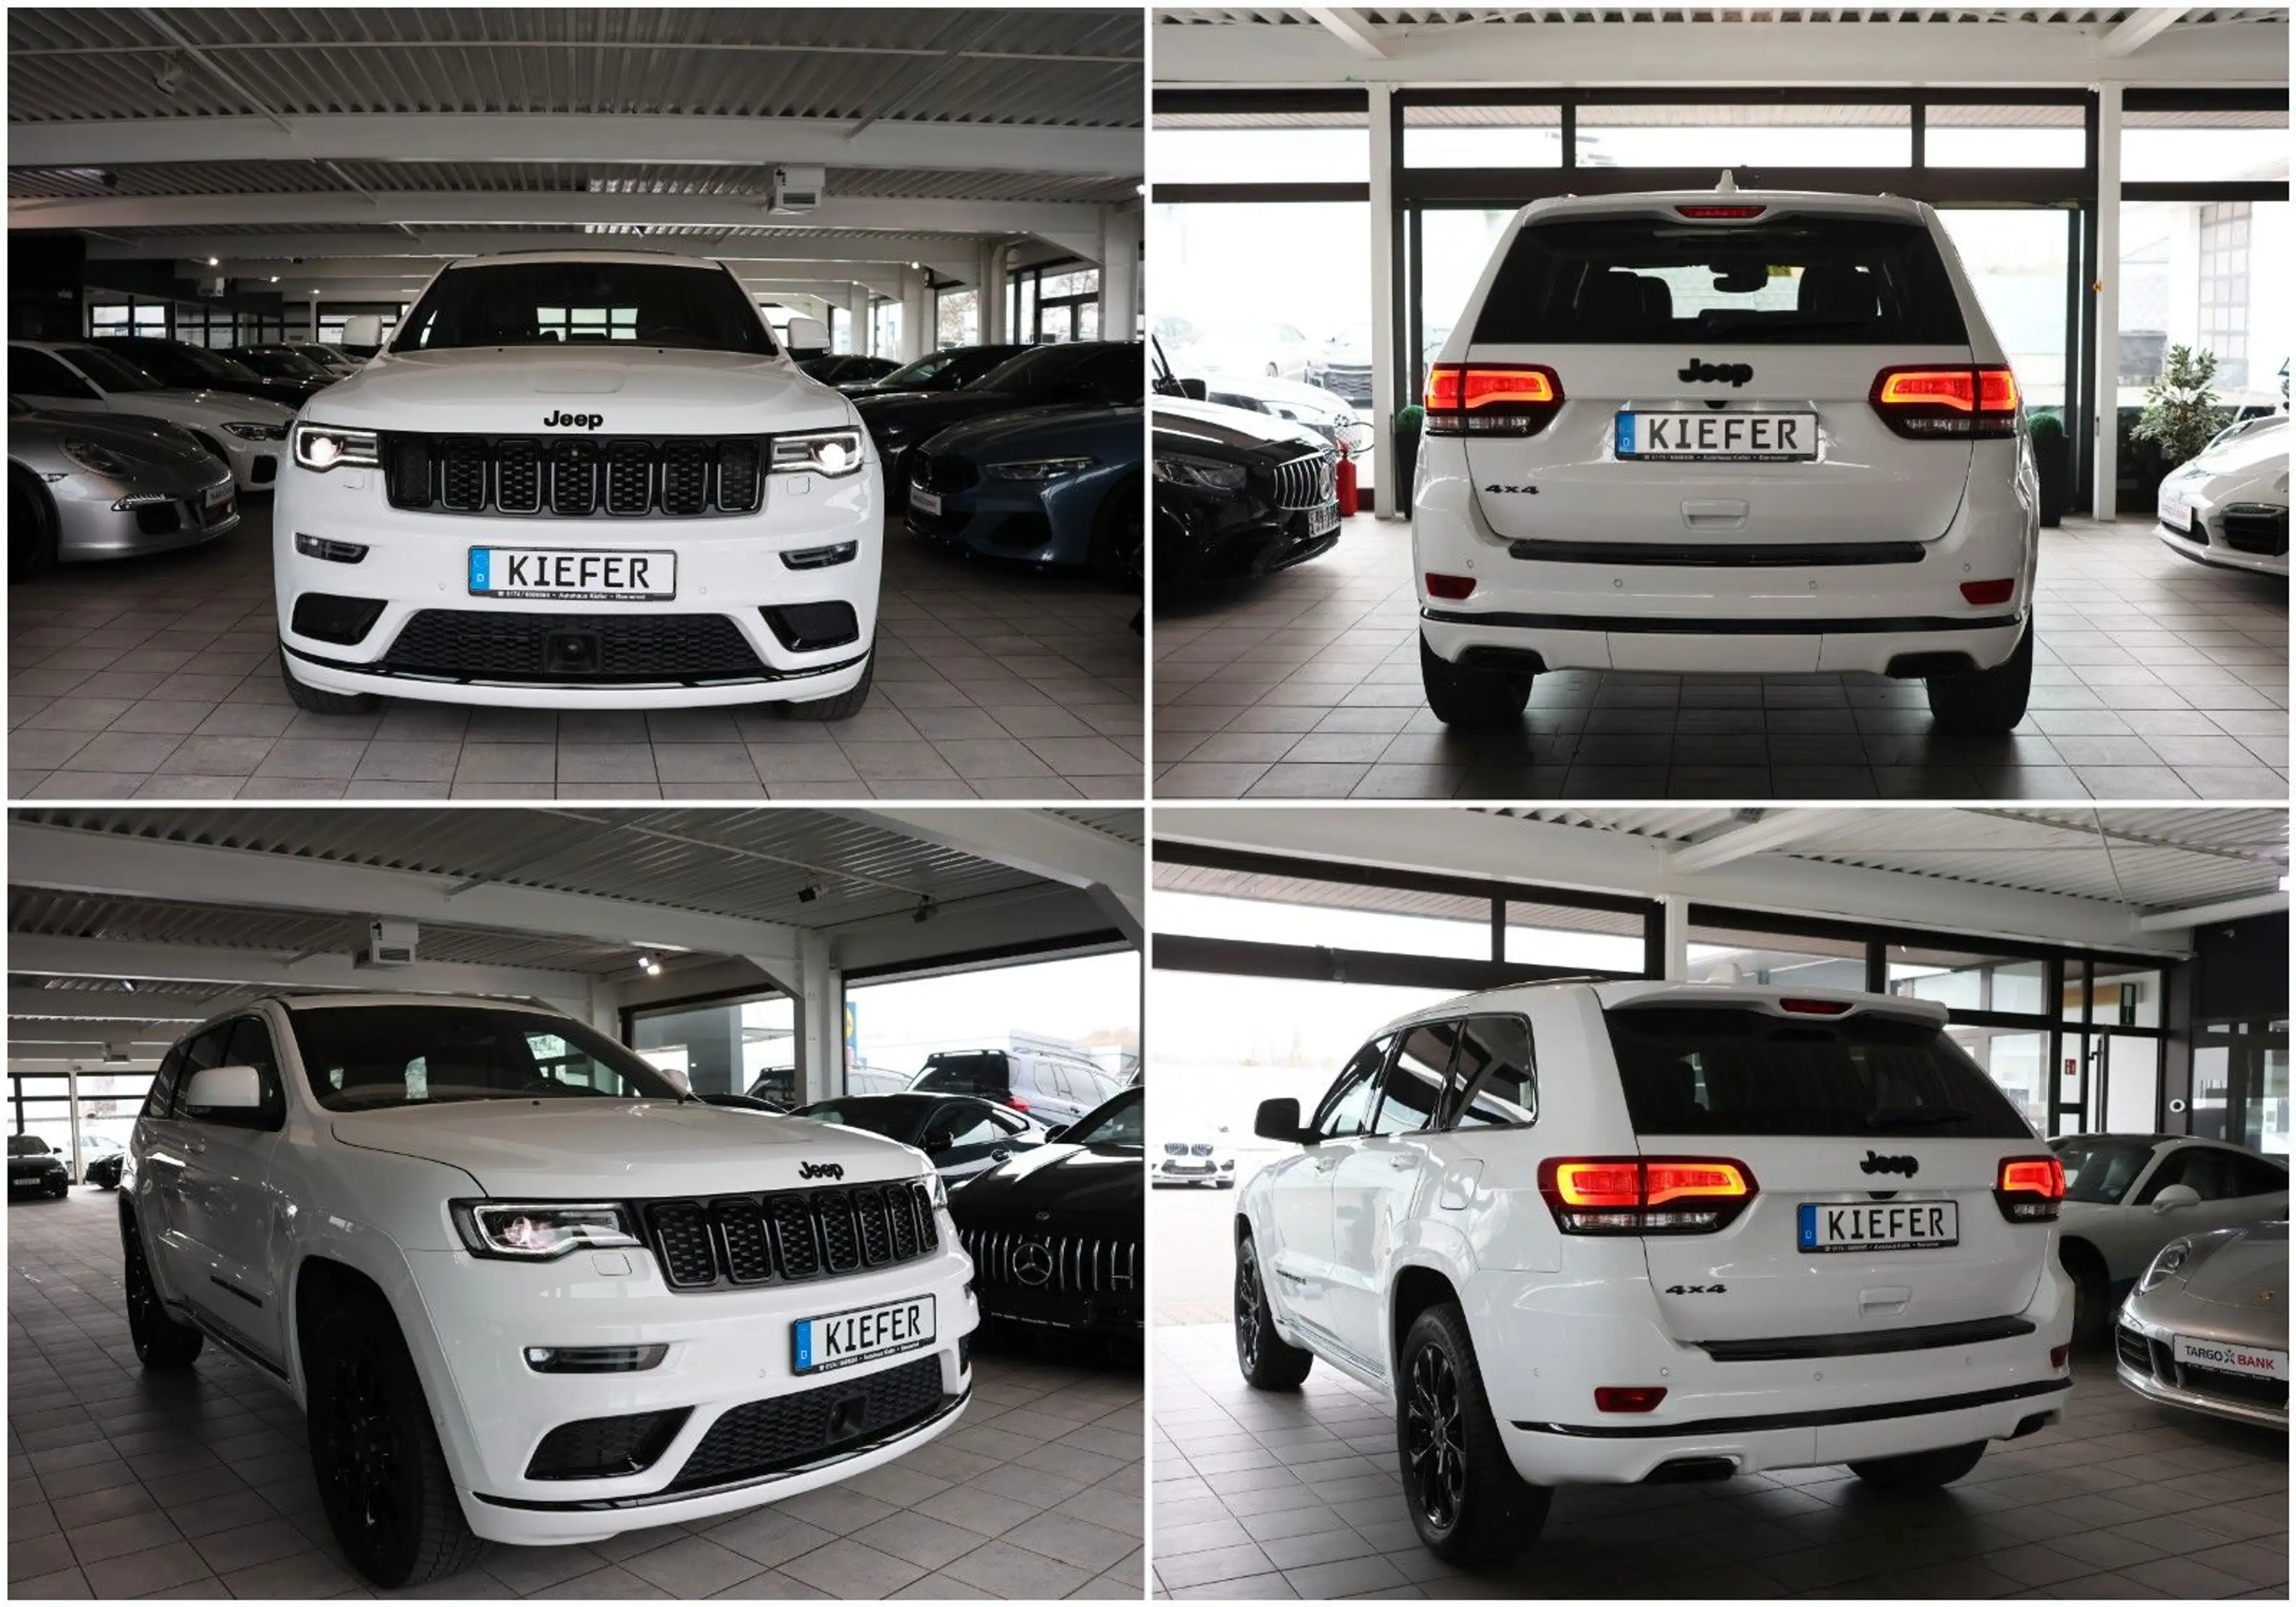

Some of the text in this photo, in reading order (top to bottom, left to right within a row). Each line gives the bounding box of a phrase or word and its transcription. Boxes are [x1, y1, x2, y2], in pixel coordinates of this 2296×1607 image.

[1677, 358, 1753, 387] Jeep
[544, 410, 603, 430] Jeep
[1649, 419, 1797, 449] KIEFER
[1485, 485, 1539, 495] 4x4
[509, 555, 649, 588] KIEFER
[798, 1161, 844, 1180] Jeep
[1860, 1150, 1919, 1178] Jeep
[1828, 1208, 1944, 1241] KIEFER
[1666, 1284, 1727, 1295] 4x4
[826, 1305, 920, 1357] KIEFER
[801, 1351, 807, 1359] D
[2184, 1345, 2274, 1370] TARGO BANK
